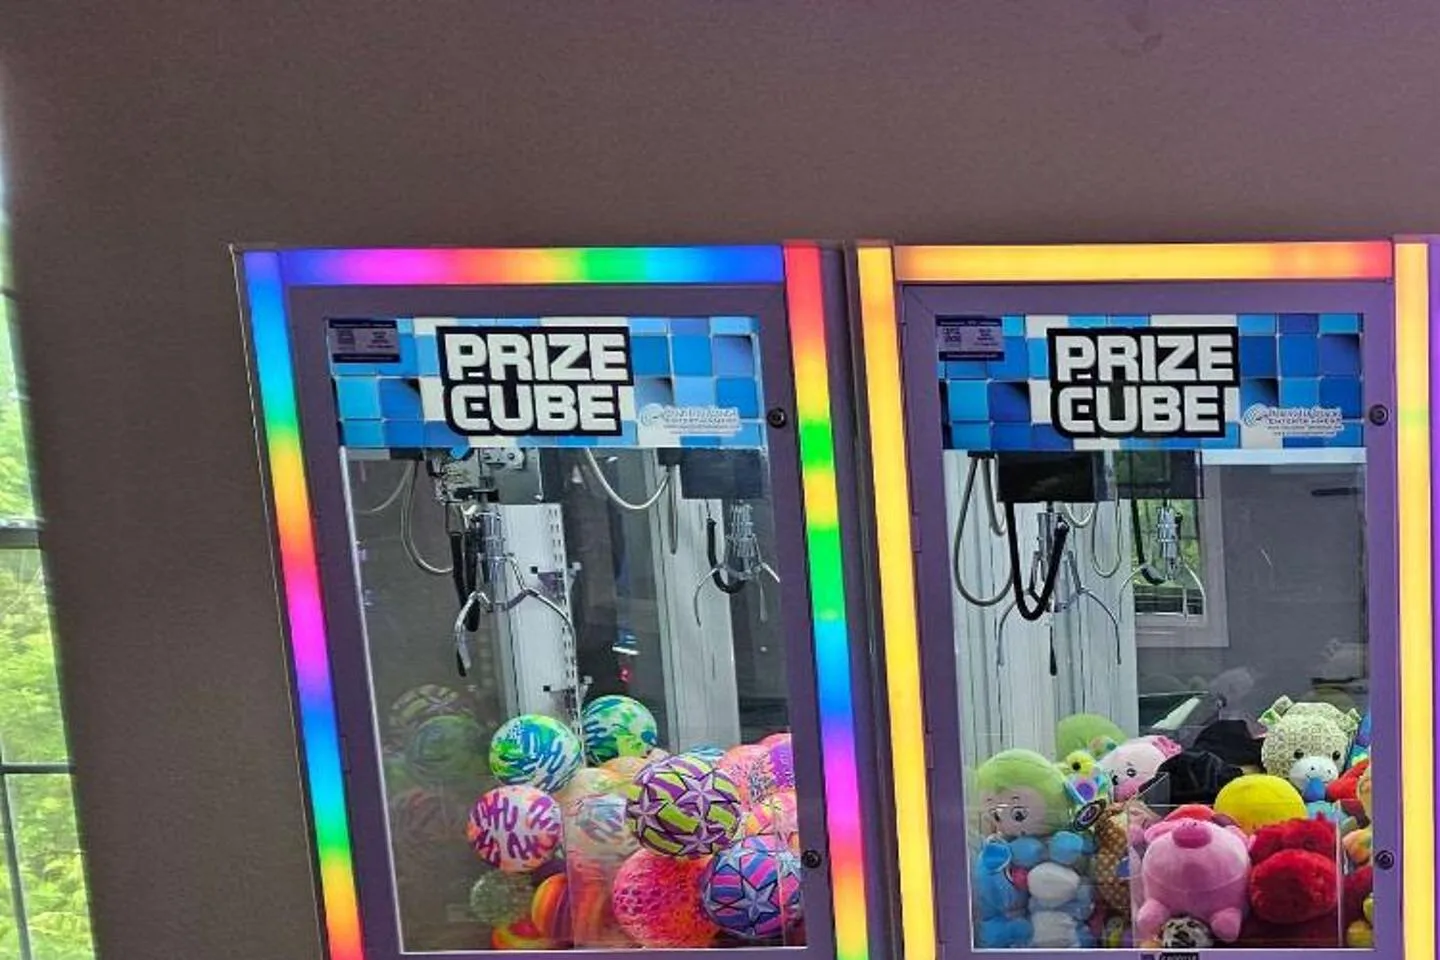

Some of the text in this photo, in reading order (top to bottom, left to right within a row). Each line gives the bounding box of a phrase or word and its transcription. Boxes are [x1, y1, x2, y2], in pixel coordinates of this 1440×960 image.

[443, 333, 629, 382] PRIZE
[1054, 334, 1236, 382] PRIZE
[448, 384, 619, 432] CUBE
[1057, 386, 1221, 434] CUBE
